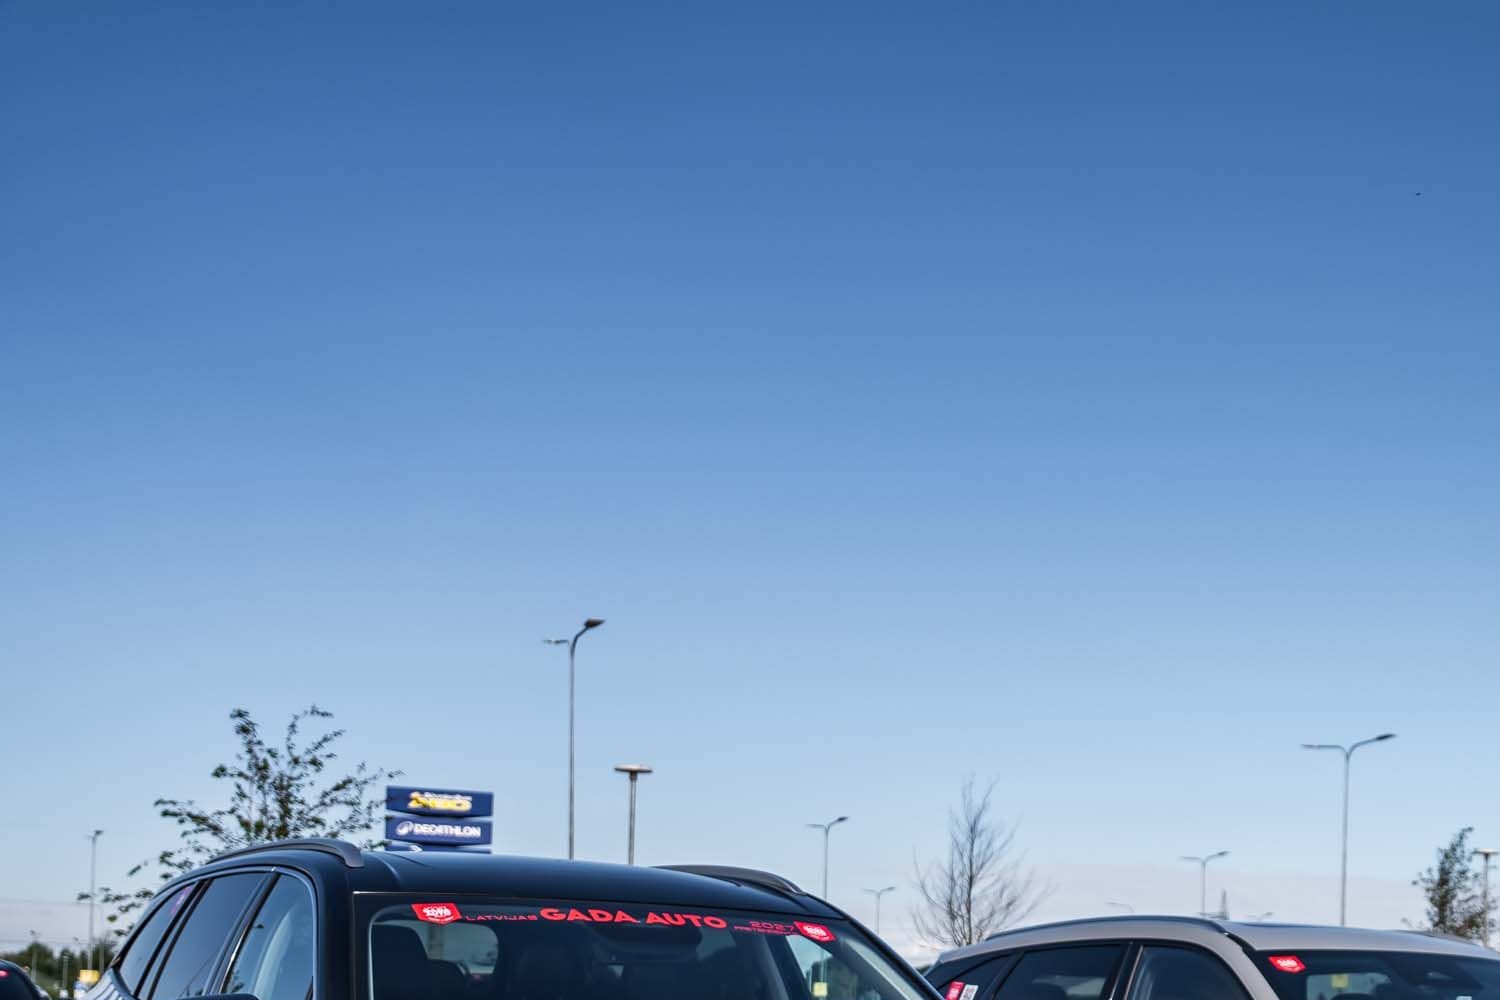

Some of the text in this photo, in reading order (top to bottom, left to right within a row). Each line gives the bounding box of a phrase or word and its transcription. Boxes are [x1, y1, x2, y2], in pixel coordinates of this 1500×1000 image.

[414, 823, 481, 838] DECATHLON
[540, 907, 640, 924] GADA
[646, 911, 728, 929] AUTO
